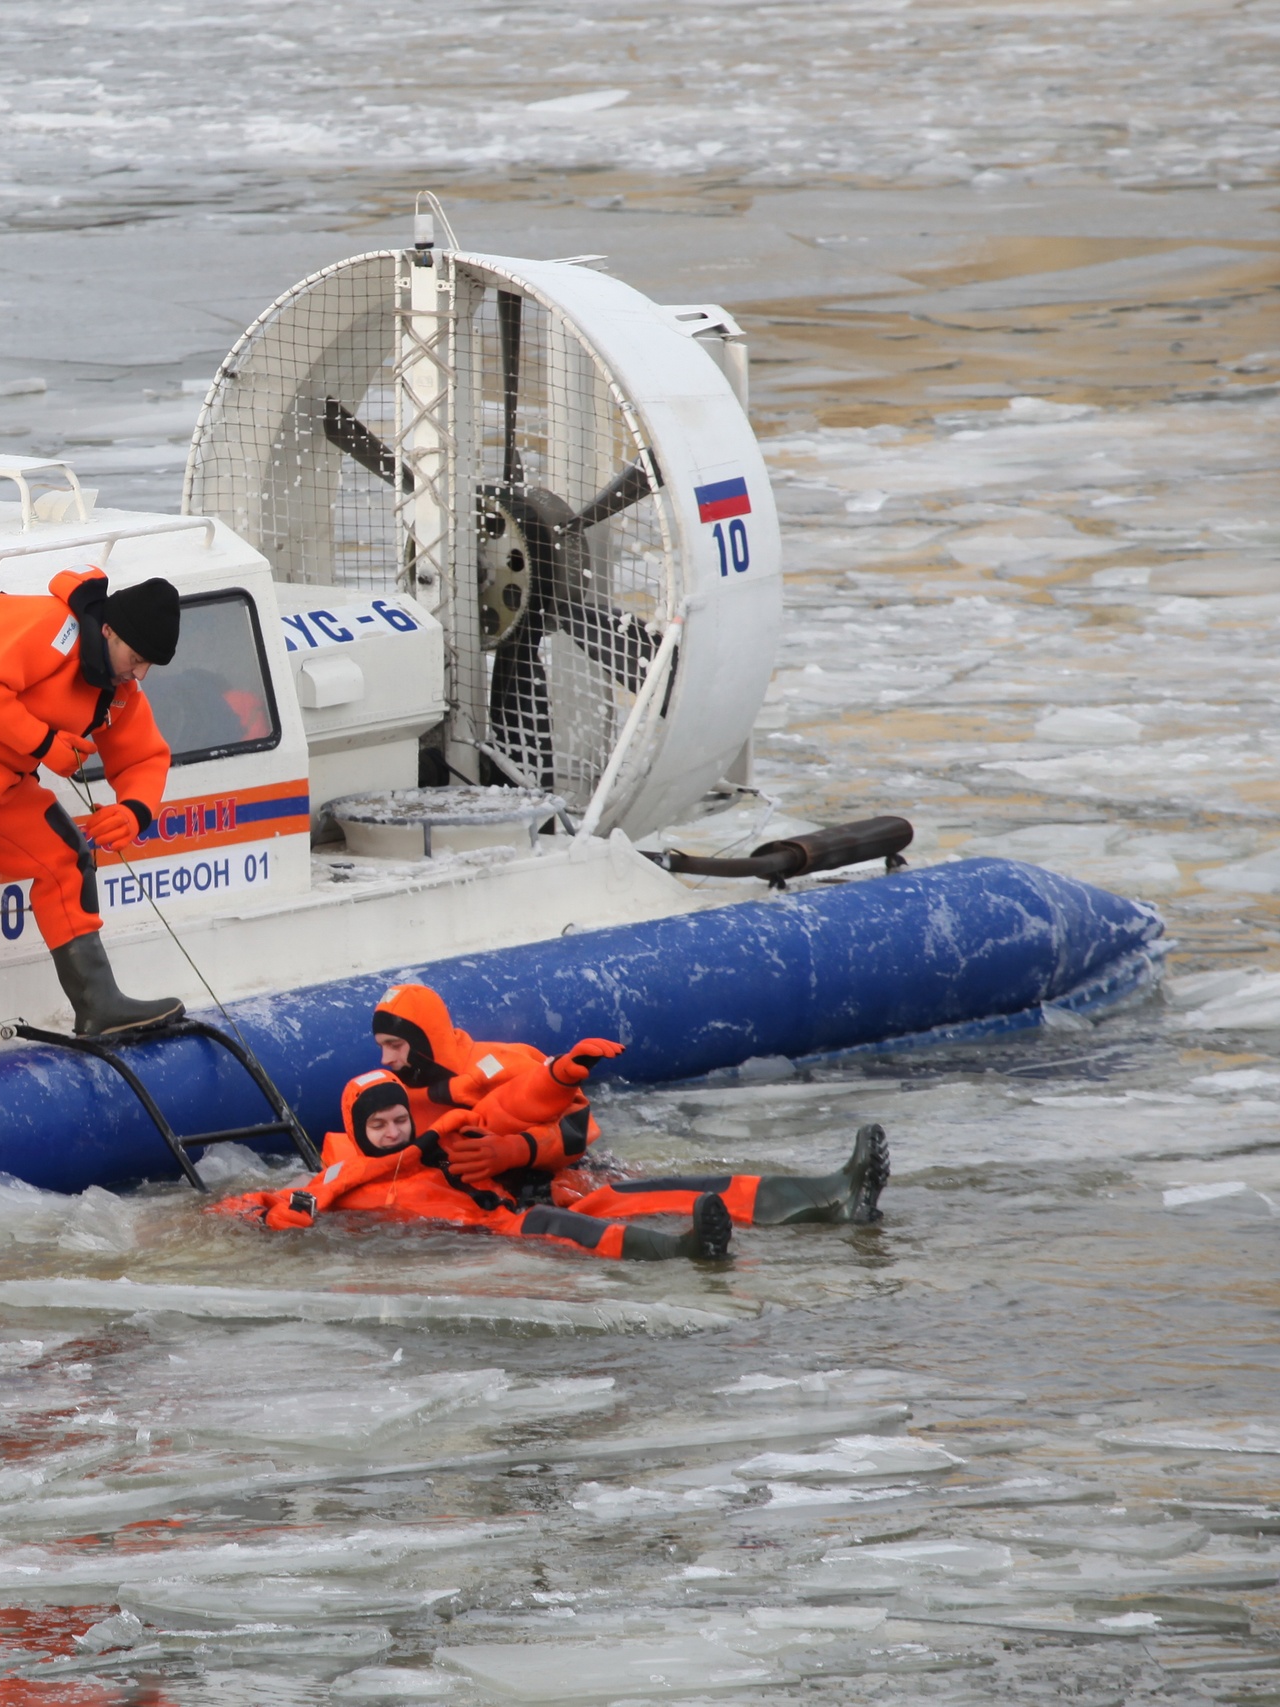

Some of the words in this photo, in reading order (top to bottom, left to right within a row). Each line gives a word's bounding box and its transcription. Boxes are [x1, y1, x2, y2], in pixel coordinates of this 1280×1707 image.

[712, 519, 749, 577] 10
[281, 600, 417, 652] УС-6
[104, 857, 229, 907] ТЕЛЕФОН
[244, 852, 268, 882] 01
